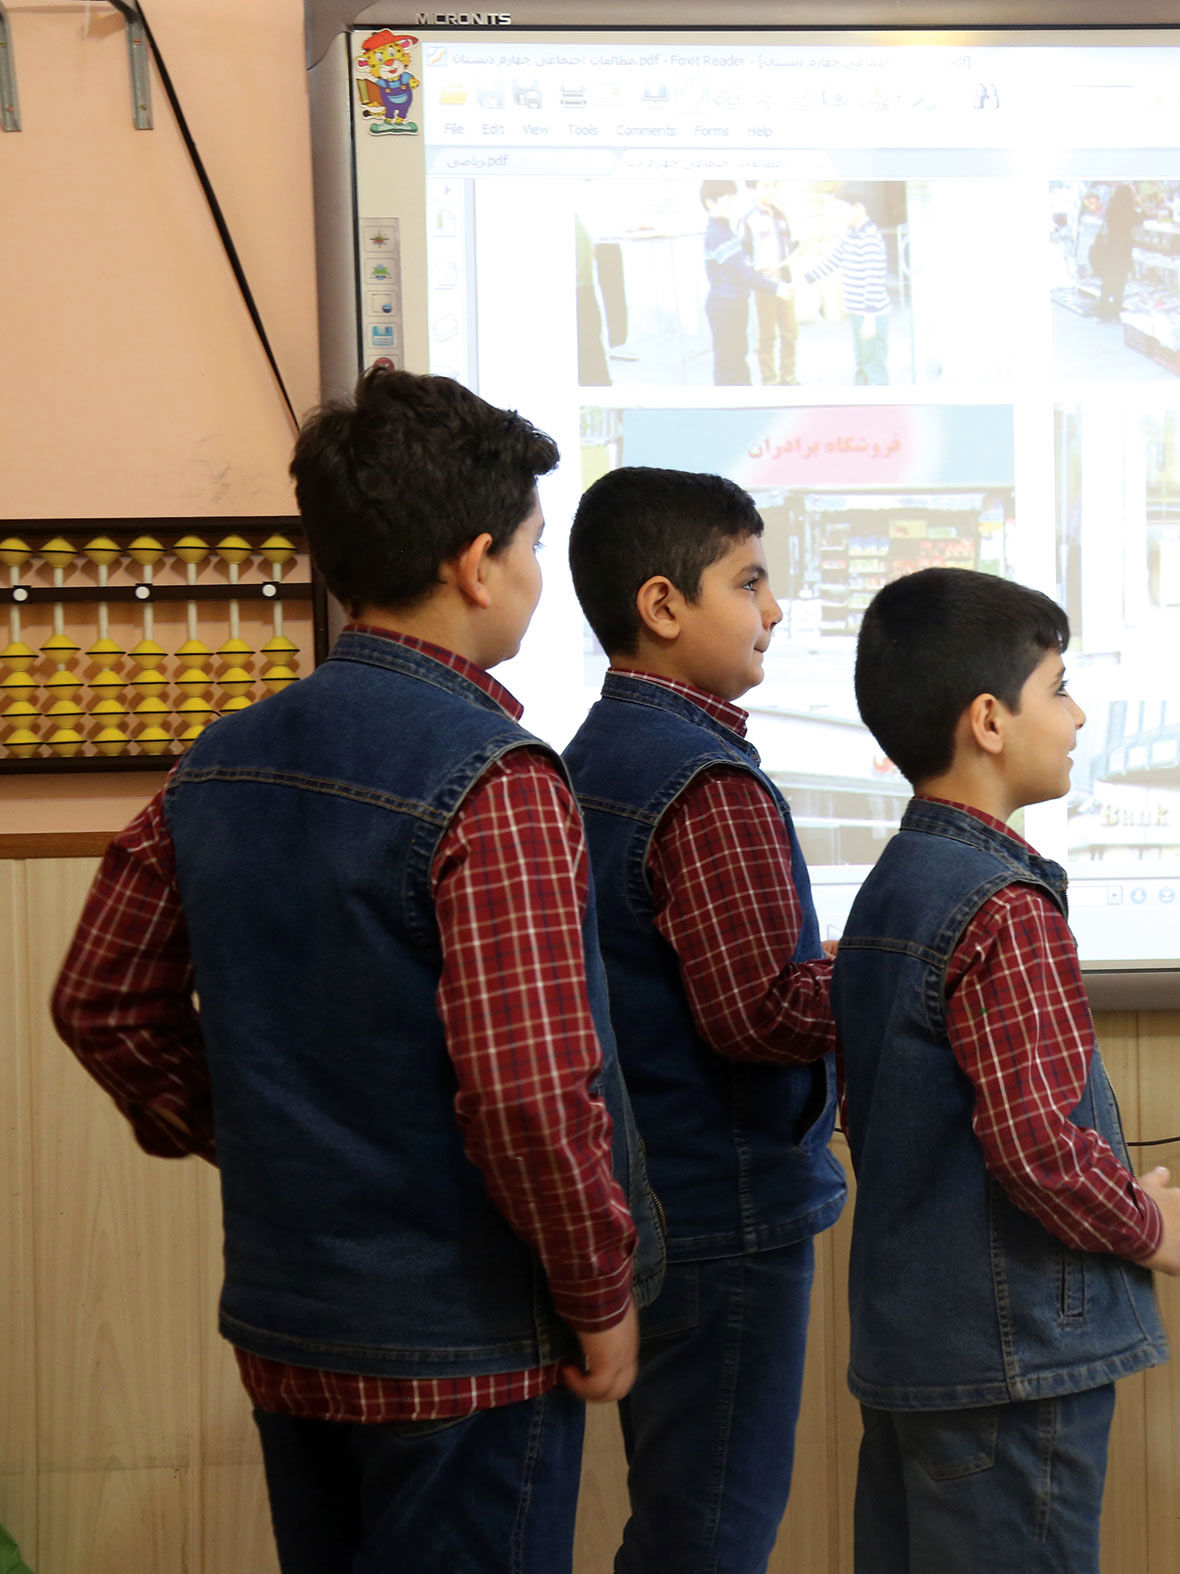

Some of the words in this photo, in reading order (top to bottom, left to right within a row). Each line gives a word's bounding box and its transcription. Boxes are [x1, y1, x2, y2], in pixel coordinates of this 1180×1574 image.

[415, 12, 512, 25] MICRONITS
[670, 54, 700, 66] Foxit
[702, 54, 745, 66] Reader
[443, 123, 464, 135] File
[481, 124, 505, 136] Edit
[522, 124, 549, 136] View
[567, 124, 599, 137] Tools
[615, 124, 677, 137] Comments
[694, 125, 730, 137] Forms
[747, 125, 774, 139] Help
[746, 436, 821, 461] برادران
[824, 432, 903, 460] فروشگاه
[1099, 802, 1171, 828] Bank
